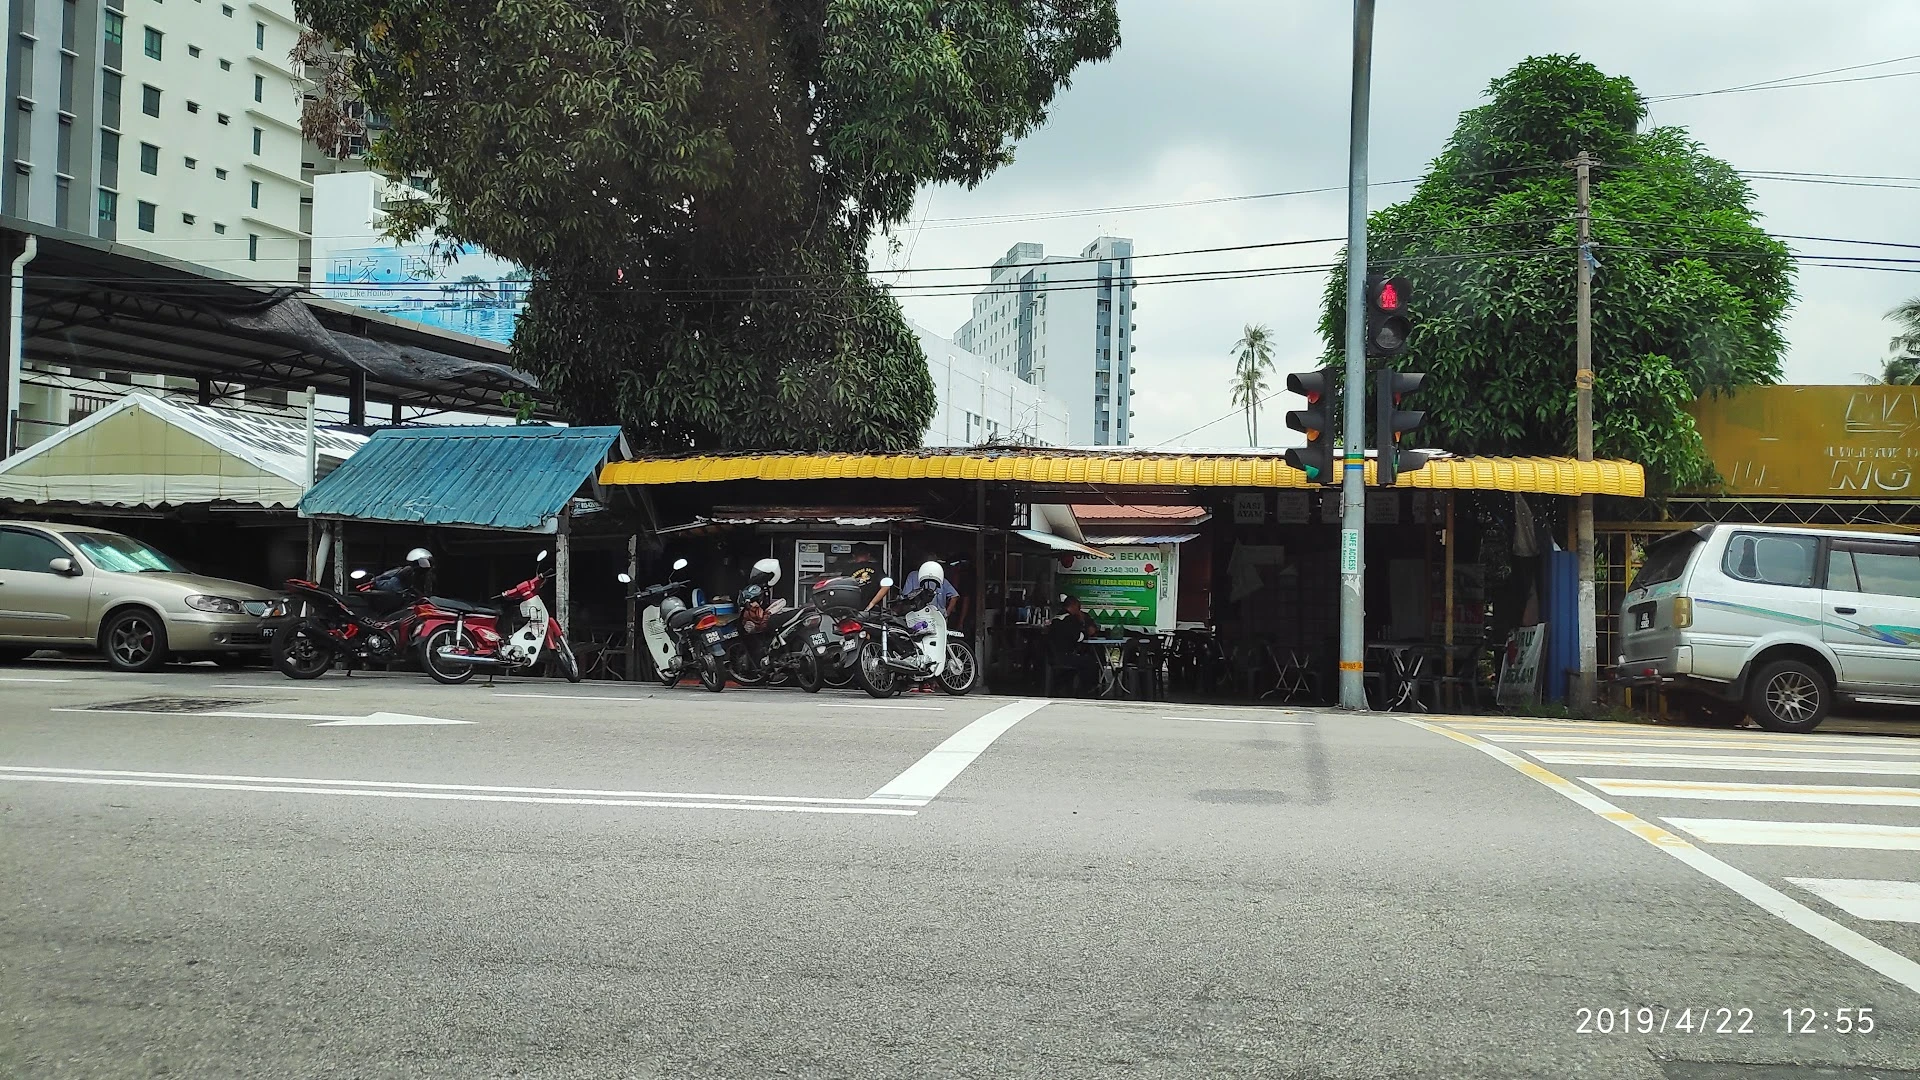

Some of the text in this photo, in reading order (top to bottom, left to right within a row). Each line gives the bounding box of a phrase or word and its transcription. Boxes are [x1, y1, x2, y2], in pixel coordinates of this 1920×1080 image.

[334, 288, 394, 298] Live Like Holiday
[1239, 502, 1261, 510] NASI
[1348, 532, 1357, 571] SAFE ACCESS
[1120, 552, 1160, 561] BEKAM
